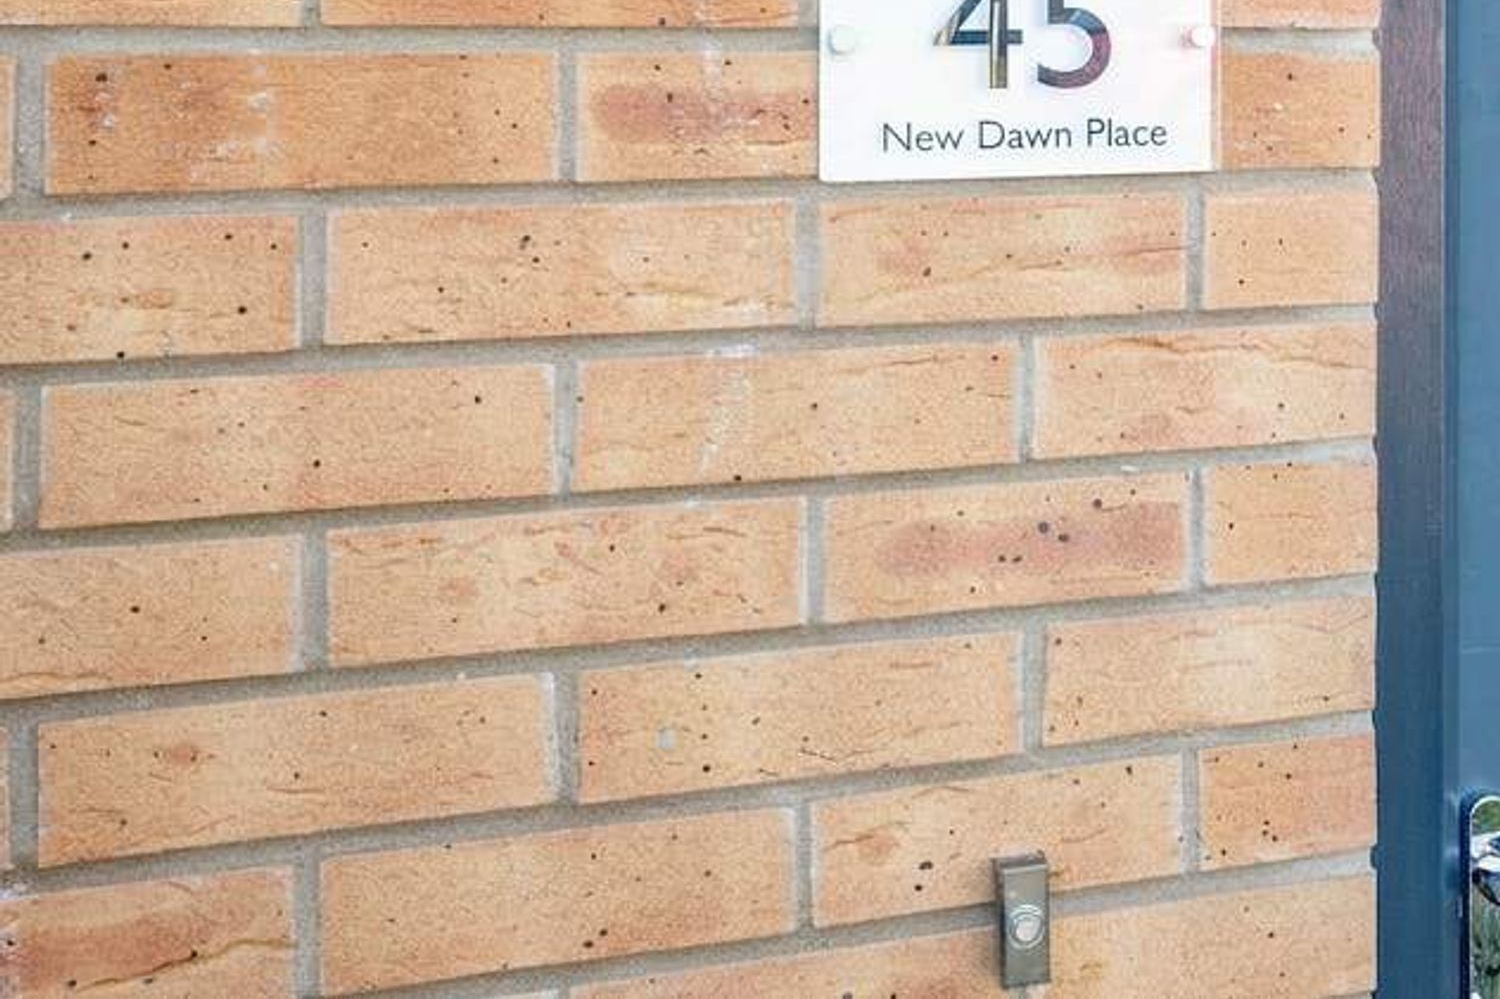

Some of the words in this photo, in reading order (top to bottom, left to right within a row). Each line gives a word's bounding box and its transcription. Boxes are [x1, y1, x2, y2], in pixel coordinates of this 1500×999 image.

[882, 123, 963, 152] New
[978, 120, 1073, 150] Dawn
[1086, 118, 1168, 148] Place
